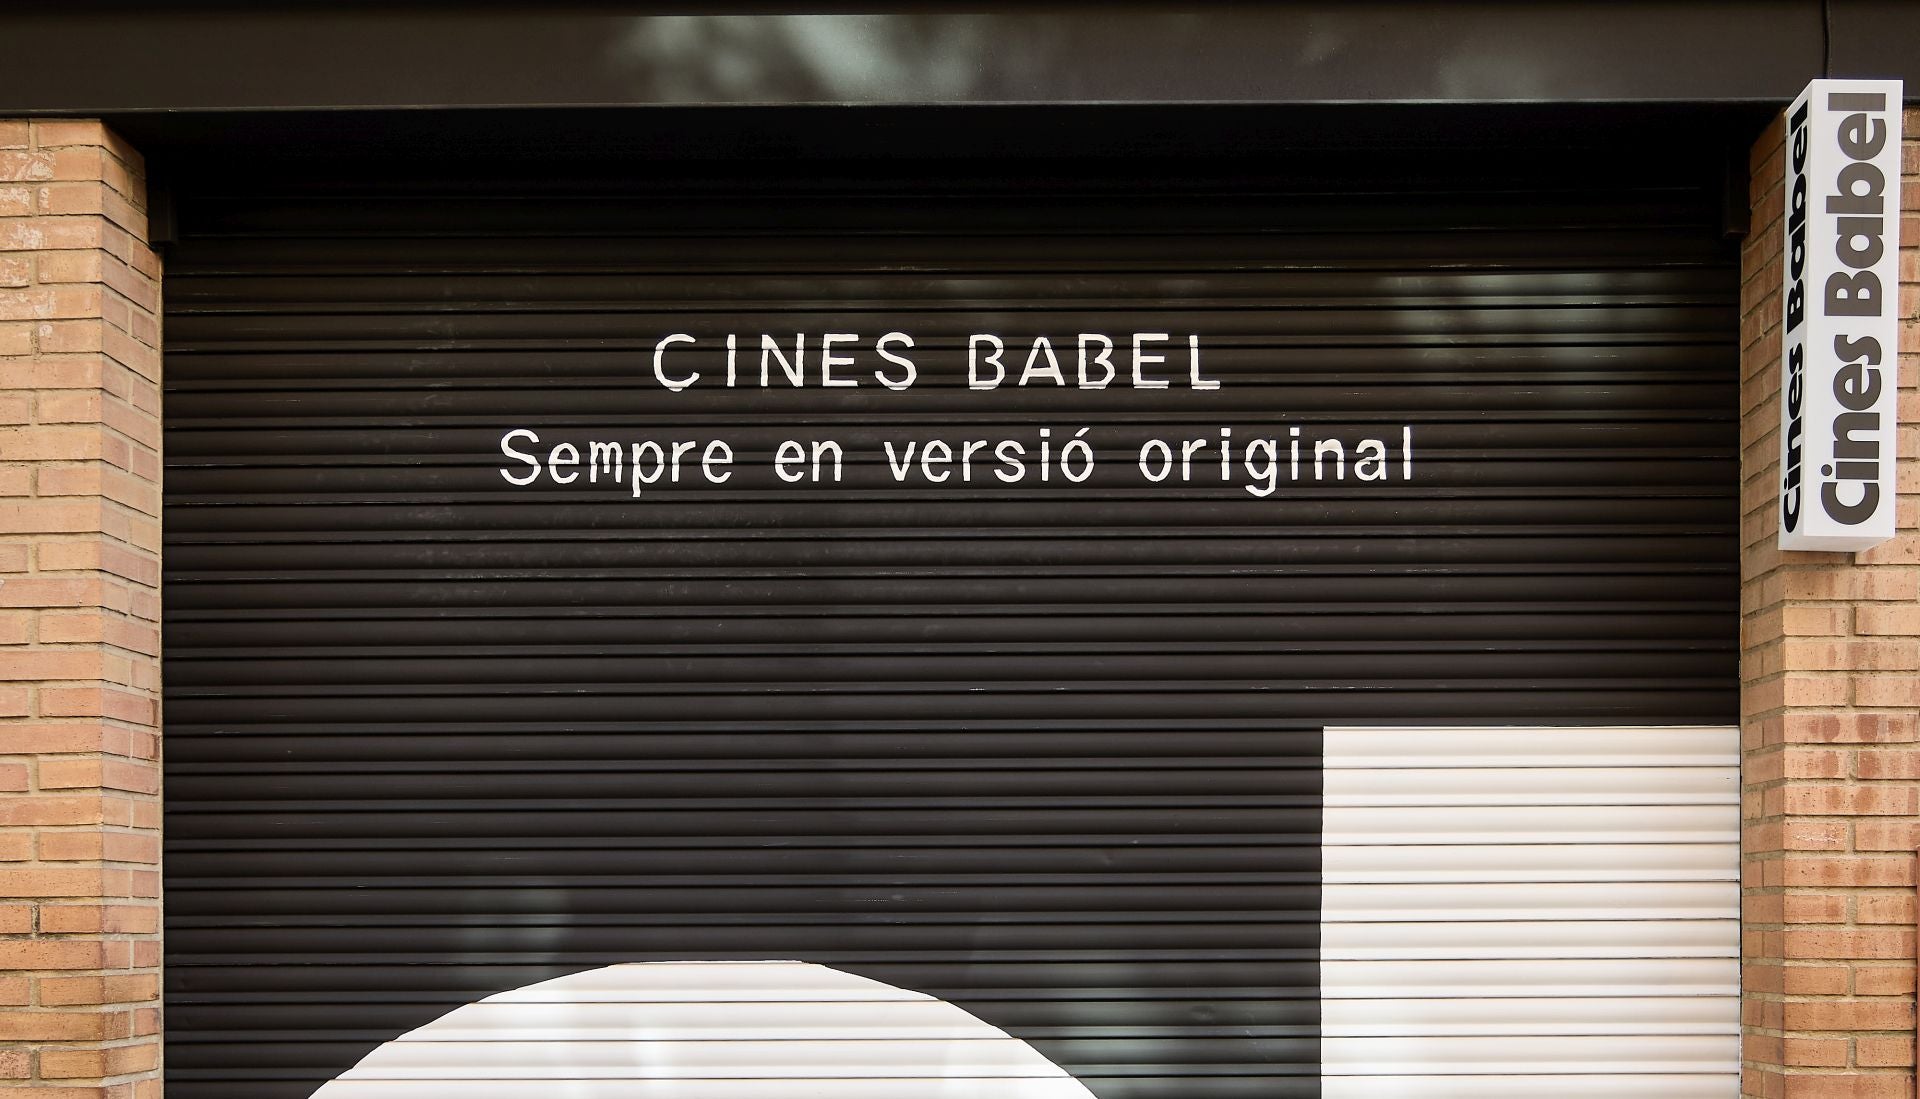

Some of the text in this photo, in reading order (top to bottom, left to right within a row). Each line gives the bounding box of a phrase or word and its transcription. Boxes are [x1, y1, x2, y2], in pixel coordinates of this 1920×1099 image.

[653, 331, 1221, 392] CINES BABEL
[1783, 99, 1809, 534] Cines Babel
[1821, 92, 1887, 525] Cines Babel
[499, 426, 1412, 498] Sempre en versió original
